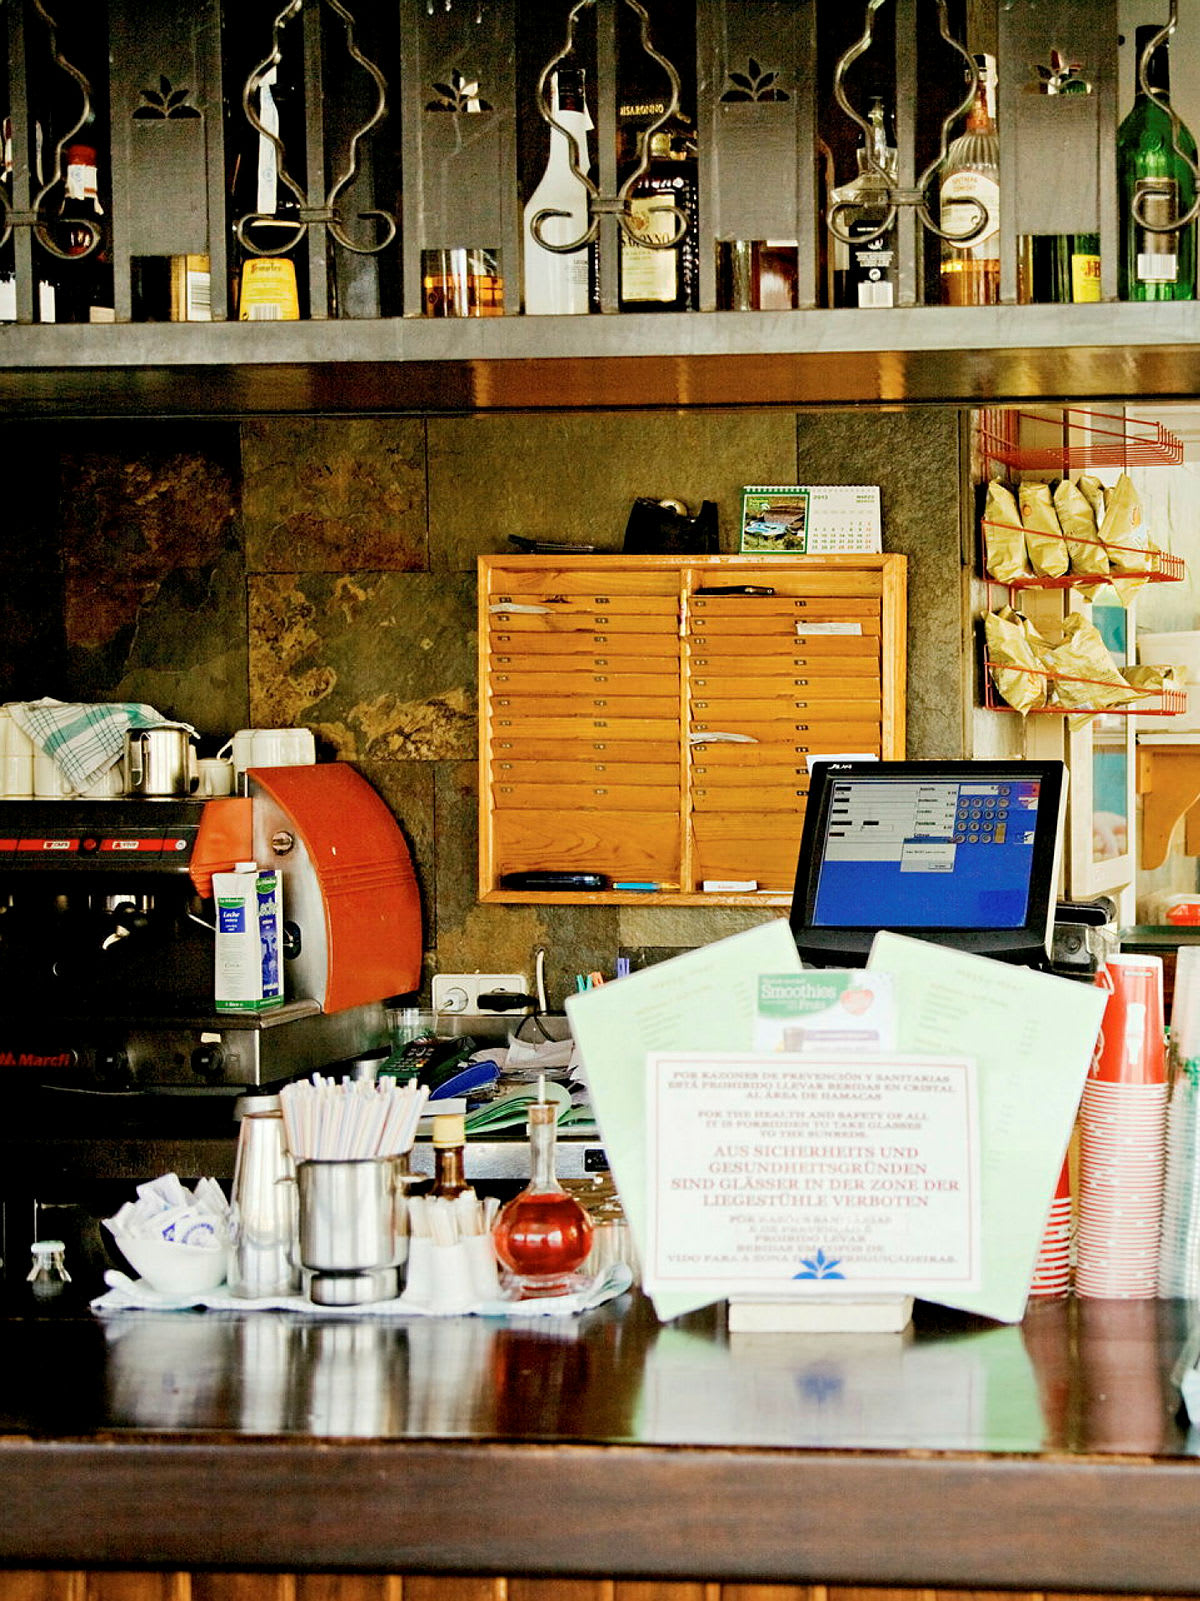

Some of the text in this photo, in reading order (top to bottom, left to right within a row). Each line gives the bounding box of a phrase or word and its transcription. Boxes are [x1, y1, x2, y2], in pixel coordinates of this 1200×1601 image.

[761, 983, 837, 1000] Smoothies
[714, 1145, 919, 1159] AUS SICHERHEITS UND
[708, 1160, 928, 1174] GESUNDHEITSGRÜNDEN
[671, 1175, 960, 1192] SIND GLÄSSER IN DER ZONE DER
[703, 1192, 929, 1207] LIEGESTÜHLE VERBOTEN
